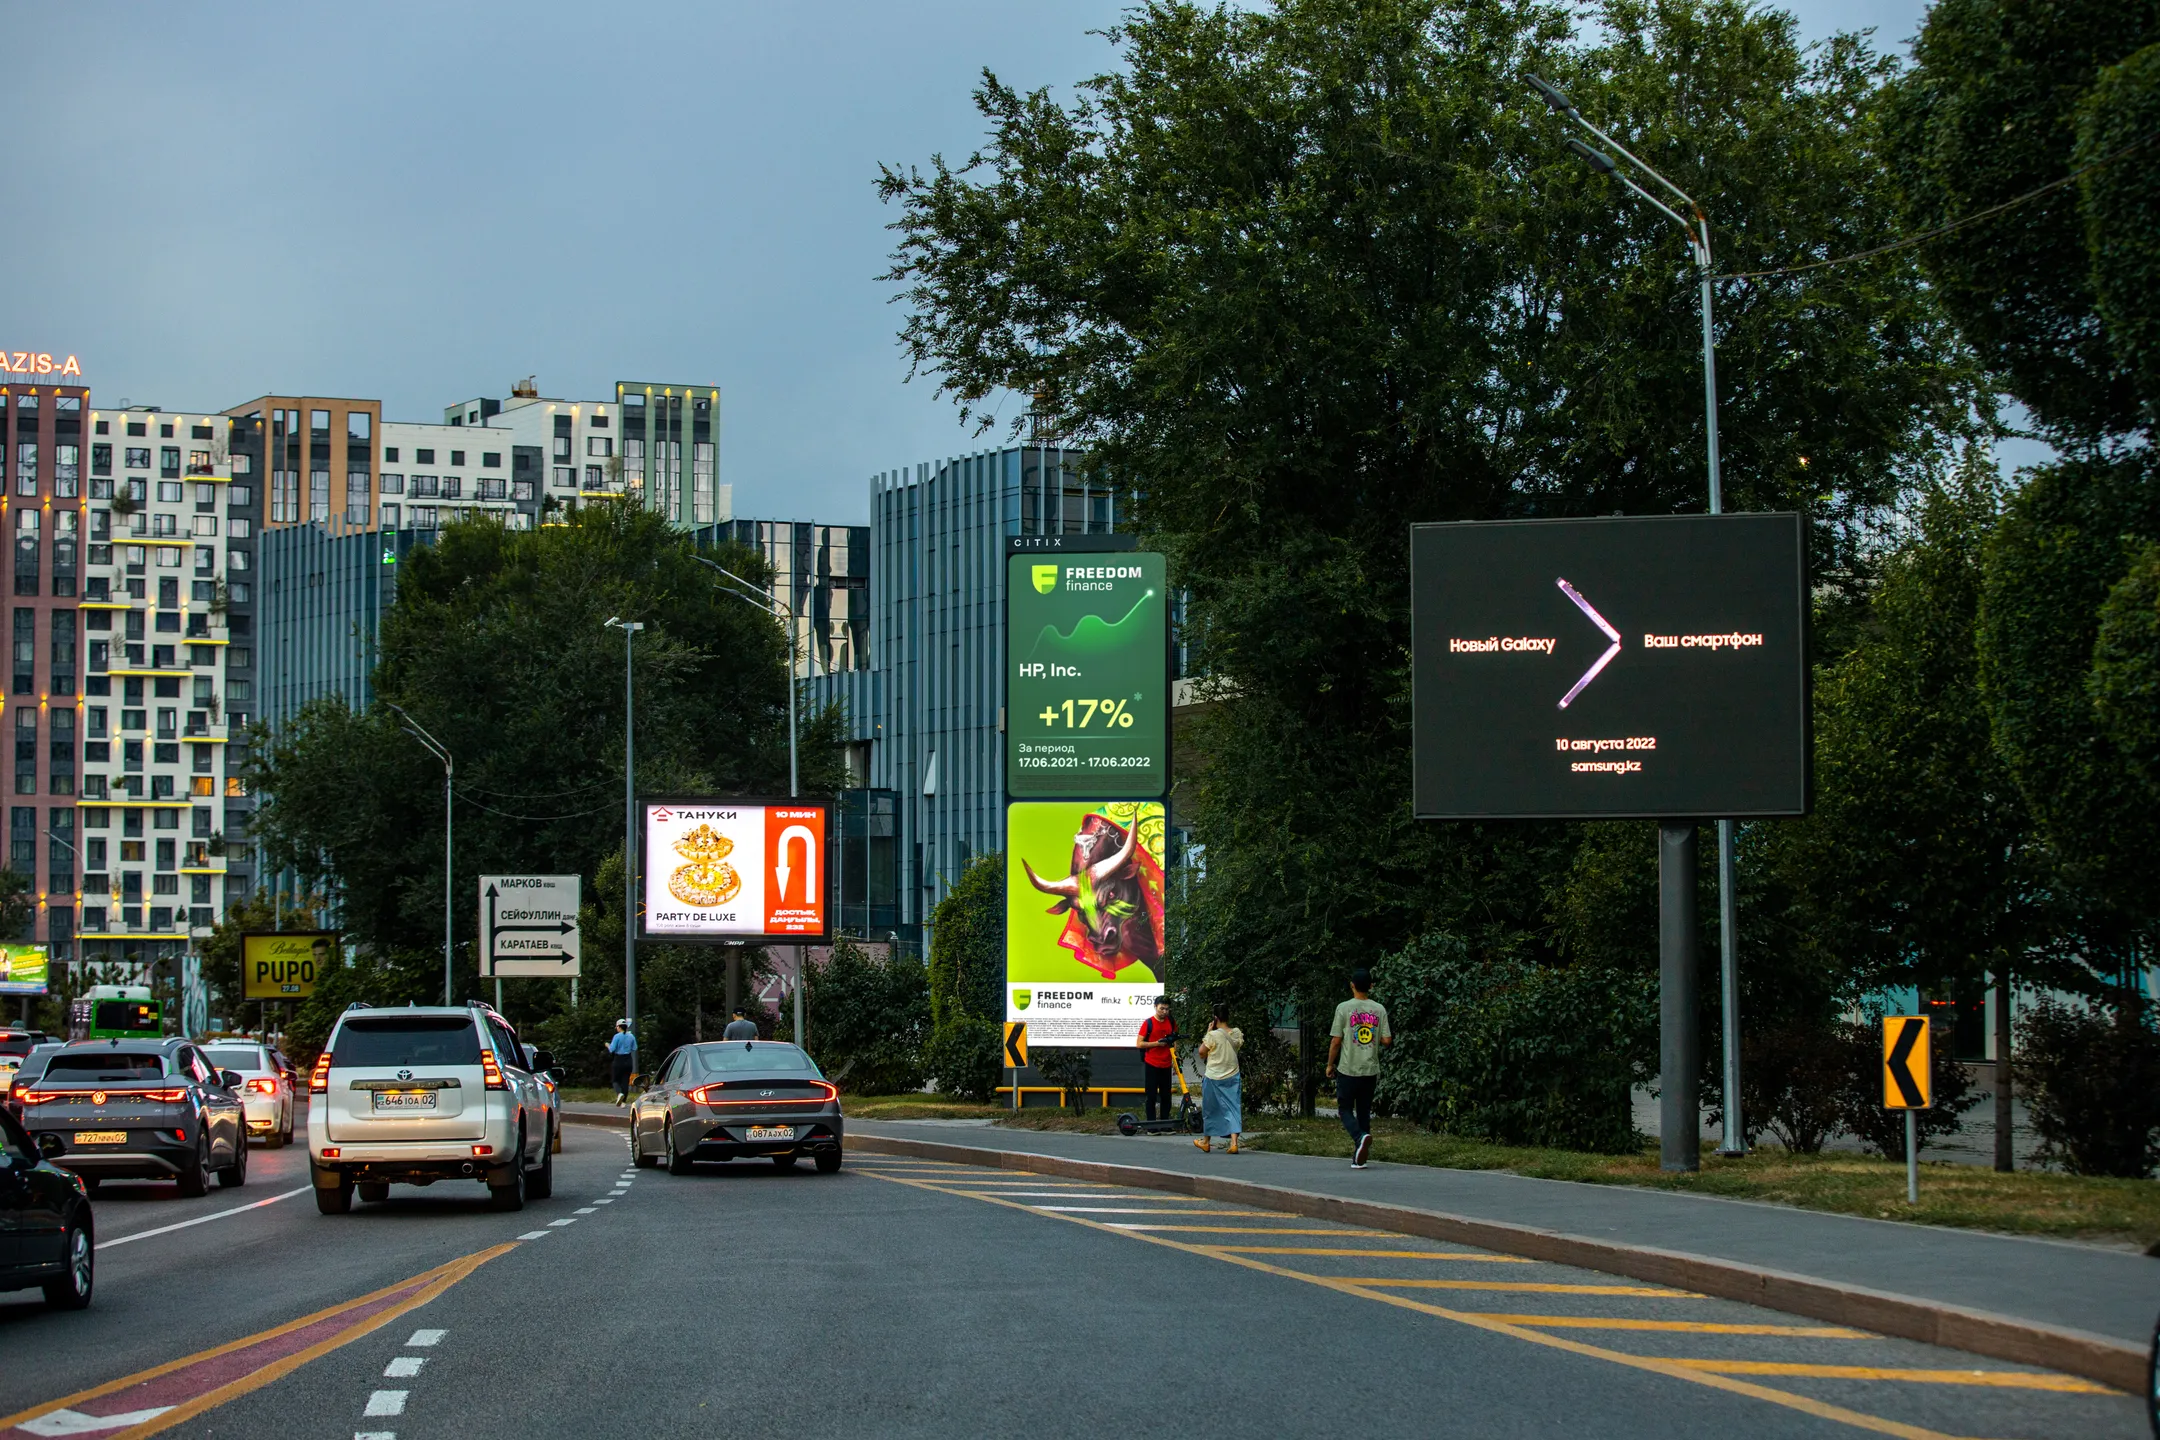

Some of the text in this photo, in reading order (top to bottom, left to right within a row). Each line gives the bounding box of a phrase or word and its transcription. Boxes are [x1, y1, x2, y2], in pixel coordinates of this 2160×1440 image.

[1014, 538, 1061, 547] CITIX
[1066, 567, 1142, 579] FREEDOM
[1066, 580, 1113, 591] finance
[1450, 636, 1556, 654] Новый Galaxy
[1644, 632, 1763, 651] Ваш смартфон
[1019, 663, 1082, 679] HP, Inc.
[1019, 743, 1075, 754] За период
[1556, 737, 1656, 753] 10 августа 2022
[1019, 758, 1078, 767] 17.06.2021
[1088, 757, 1150, 767] 17.06.2022
[1571, 760, 1642, 774] samsung.kz
[677, 811, 737, 820] ТАНУКИ
[775, 811, 817, 819] 10 МИН
[501, 879, 542, 888] МАРКОВ
[501, 909, 561, 920] СЕЙФУЛЛИН
[656, 912, 736, 921] PARTY DE LUXE
[501, 940, 549, 949] КАРАТАЕВ
[256, 961, 314, 983] PUPO
[1037, 992, 1093, 1000] FREEDOM
[1101, 996, 1121, 1005] ffin.kz
[1037, 1000, 1072, 1009] finance
[385, 1095, 403, 1105] 646
[422, 1095, 434, 1104] 02
[83, 1133, 98, 1142] 727
[115, 1133, 126, 1142] 02
[752, 1129, 768, 1138] 087
[783, 1129, 793, 1137] 02
